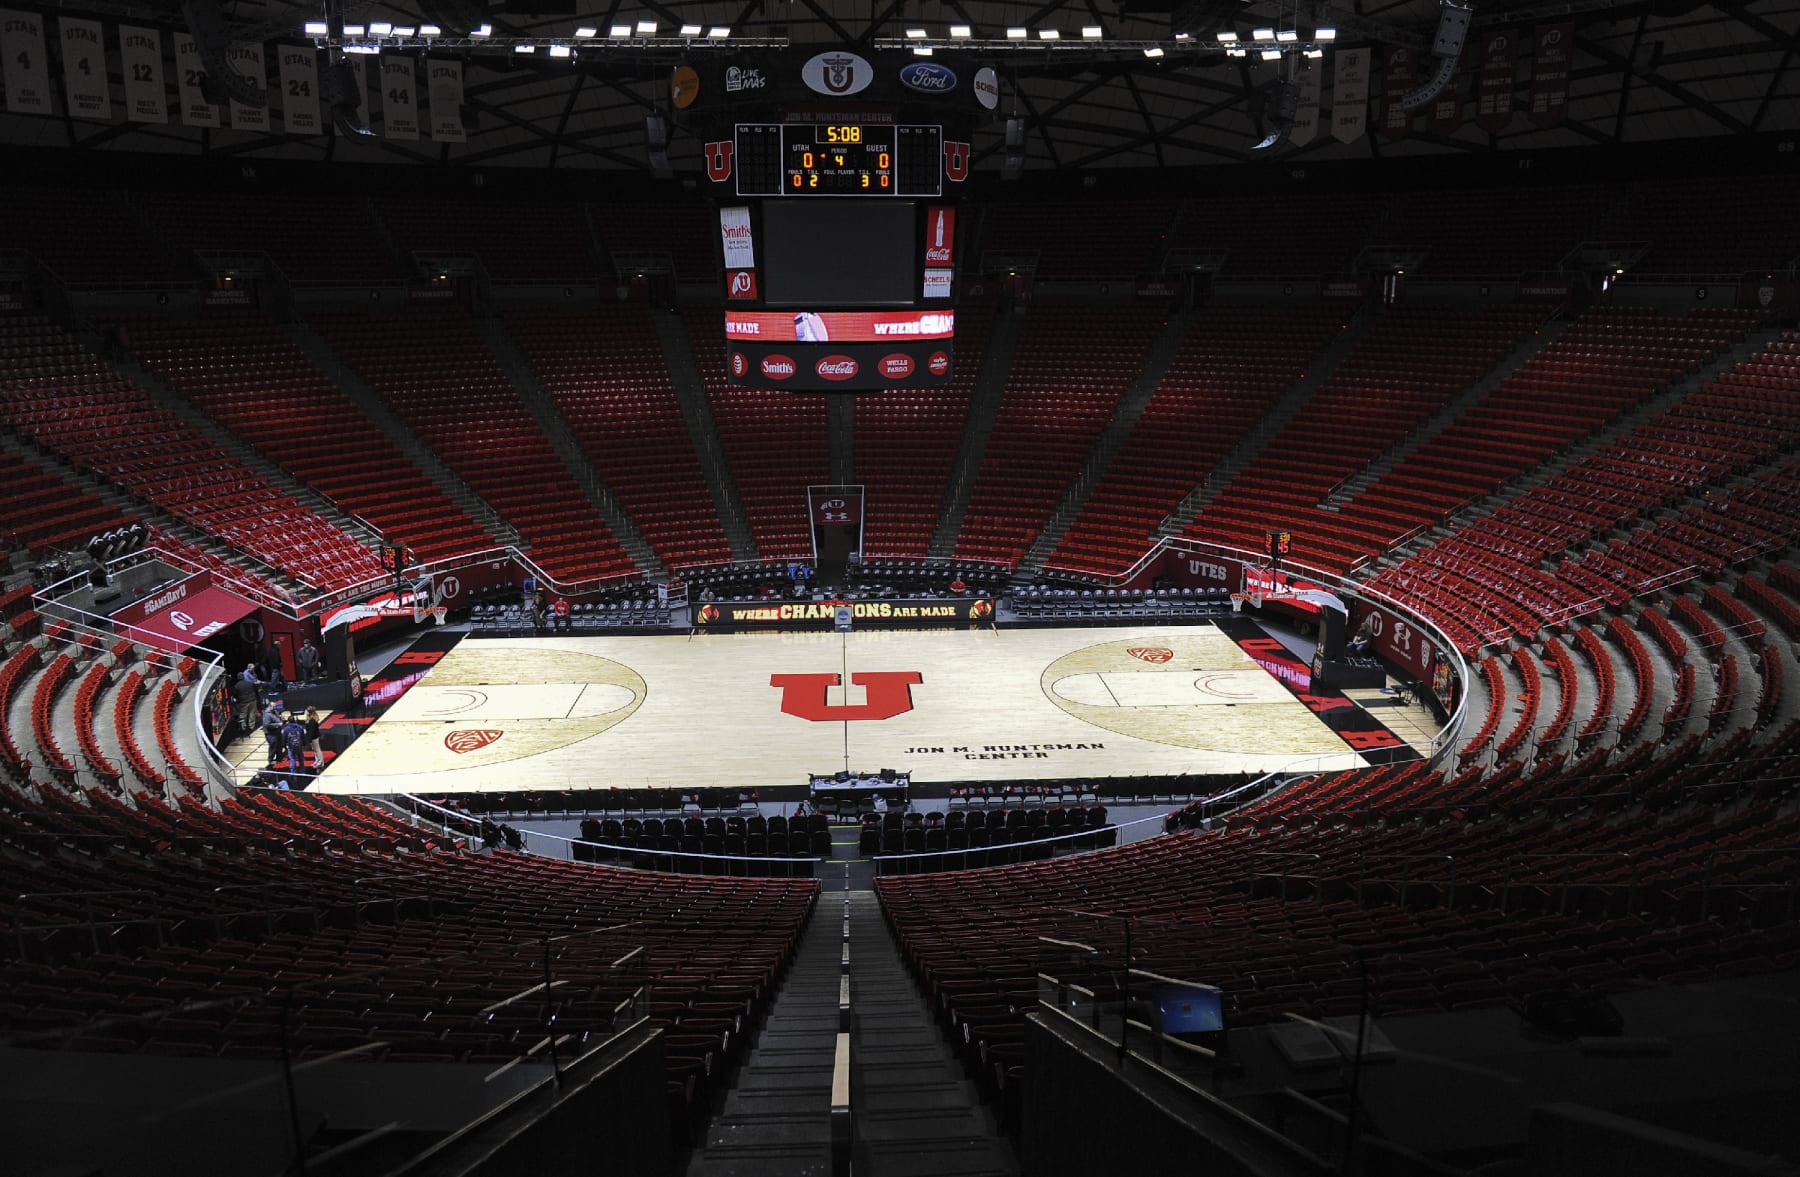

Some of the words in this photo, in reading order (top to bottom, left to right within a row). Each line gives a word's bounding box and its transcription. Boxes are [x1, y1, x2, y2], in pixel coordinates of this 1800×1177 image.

[5, 21, 37, 36] UTAH
[66, 28, 97, 44] UTAH
[126, 36, 155, 51] UTAH
[181, 43, 199, 54] UTA
[18, 51, 30, 69] 4
[231, 49, 259, 63] UTAH
[285, 54, 311, 68] UTAH
[78, 57, 91, 75] 4
[133, 63, 152, 82] 12
[385, 63, 409, 76] UTAH
[432, 67, 457, 80] UTAH
[911, 66, 947, 88] Ford
[288, 79, 310, 97] 24
[389, 88, 409, 104] 44
[785, 112, 801, 121] JON
[815, 112, 861, 121] HUNTSMAN
[862, 113, 892, 121] CENTER
[827, 126, 860, 143] 5:08
[792, 144, 810, 152] UTAH
[866, 144, 888, 152] GUEST
[803, 152, 814, 168] 0
[835, 154, 844, 166] 4
[879, 153, 889, 168] 0
[793, 174, 802, 187] 0
[809, 174, 818, 187] 2
[861, 174, 869, 187] 3
[880, 174, 889, 187] 0
[723, 224, 752, 238] Smith's
[1698, 289, 1705, 298] S
[736, 322, 760, 335] MADE
[874, 322, 920, 335] WHERE
[763, 360, 793, 374] Smith's
[818, 361, 856, 375] Coca-Cola
[1189, 560, 1227, 581] UTES
[732, 609, 780, 620] WHERE
[780, 603, 892, 620] CHAMIONS
[893, 606, 918, 617] ARE
[920, 606, 957, 617] MADE
[983, 743, 1105, 752] HUNTSMAN
[965, 752, 1048, 760] CENTER
